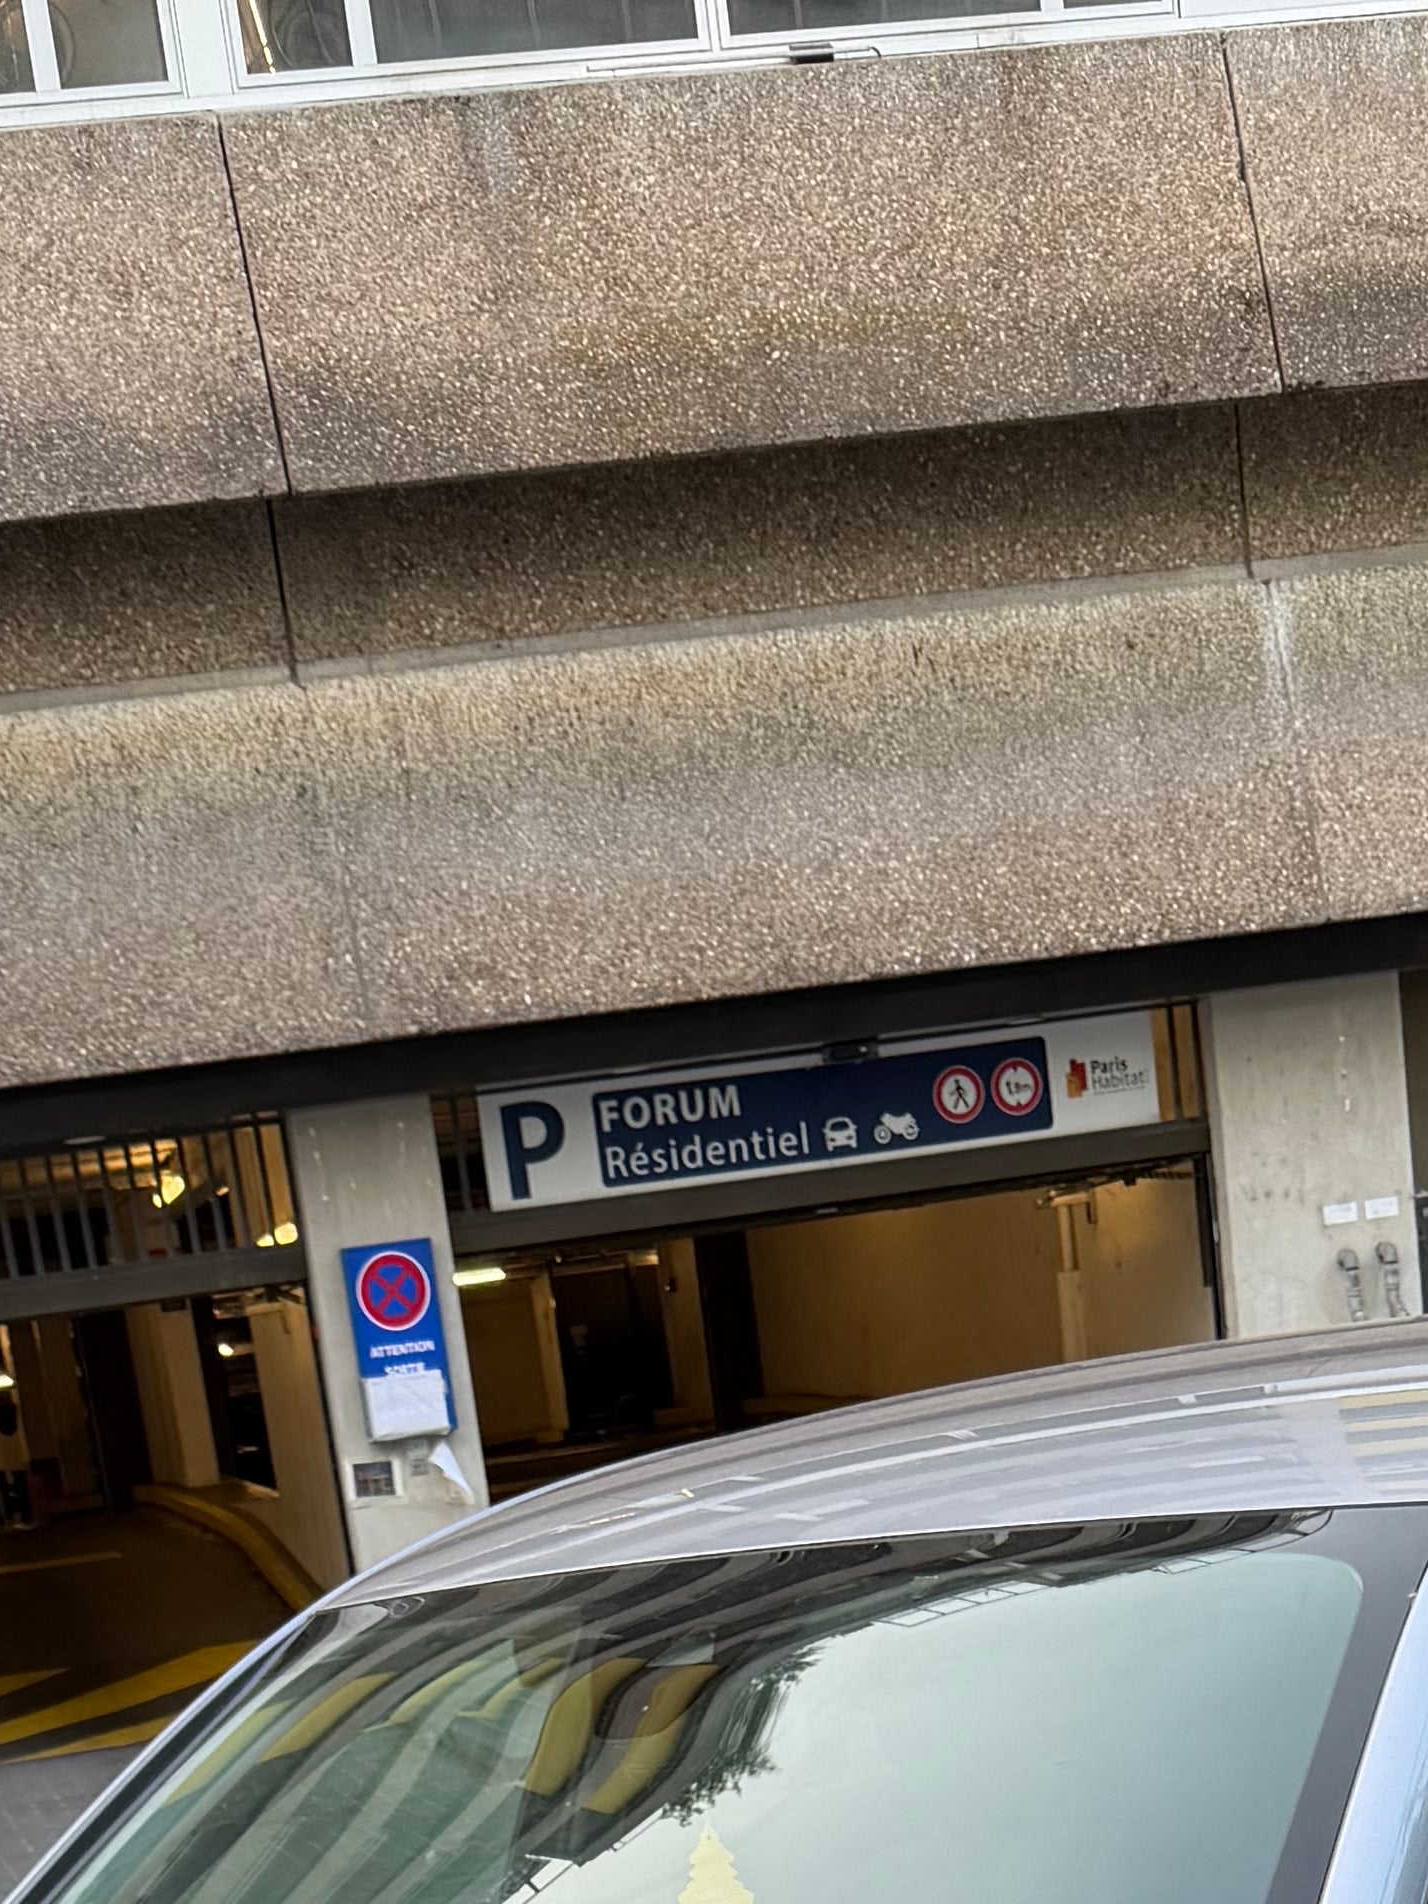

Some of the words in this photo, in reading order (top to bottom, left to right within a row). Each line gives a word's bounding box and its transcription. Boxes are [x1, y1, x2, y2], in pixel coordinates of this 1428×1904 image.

[1090, 1056, 1129, 1075] Paris
[598, 1084, 742, 1133] FORUM
[501, 1101, 565, 1199] P
[605, 1120, 810, 1180] Résidentiel
[369, 1339, 436, 1359] ATTENTION
